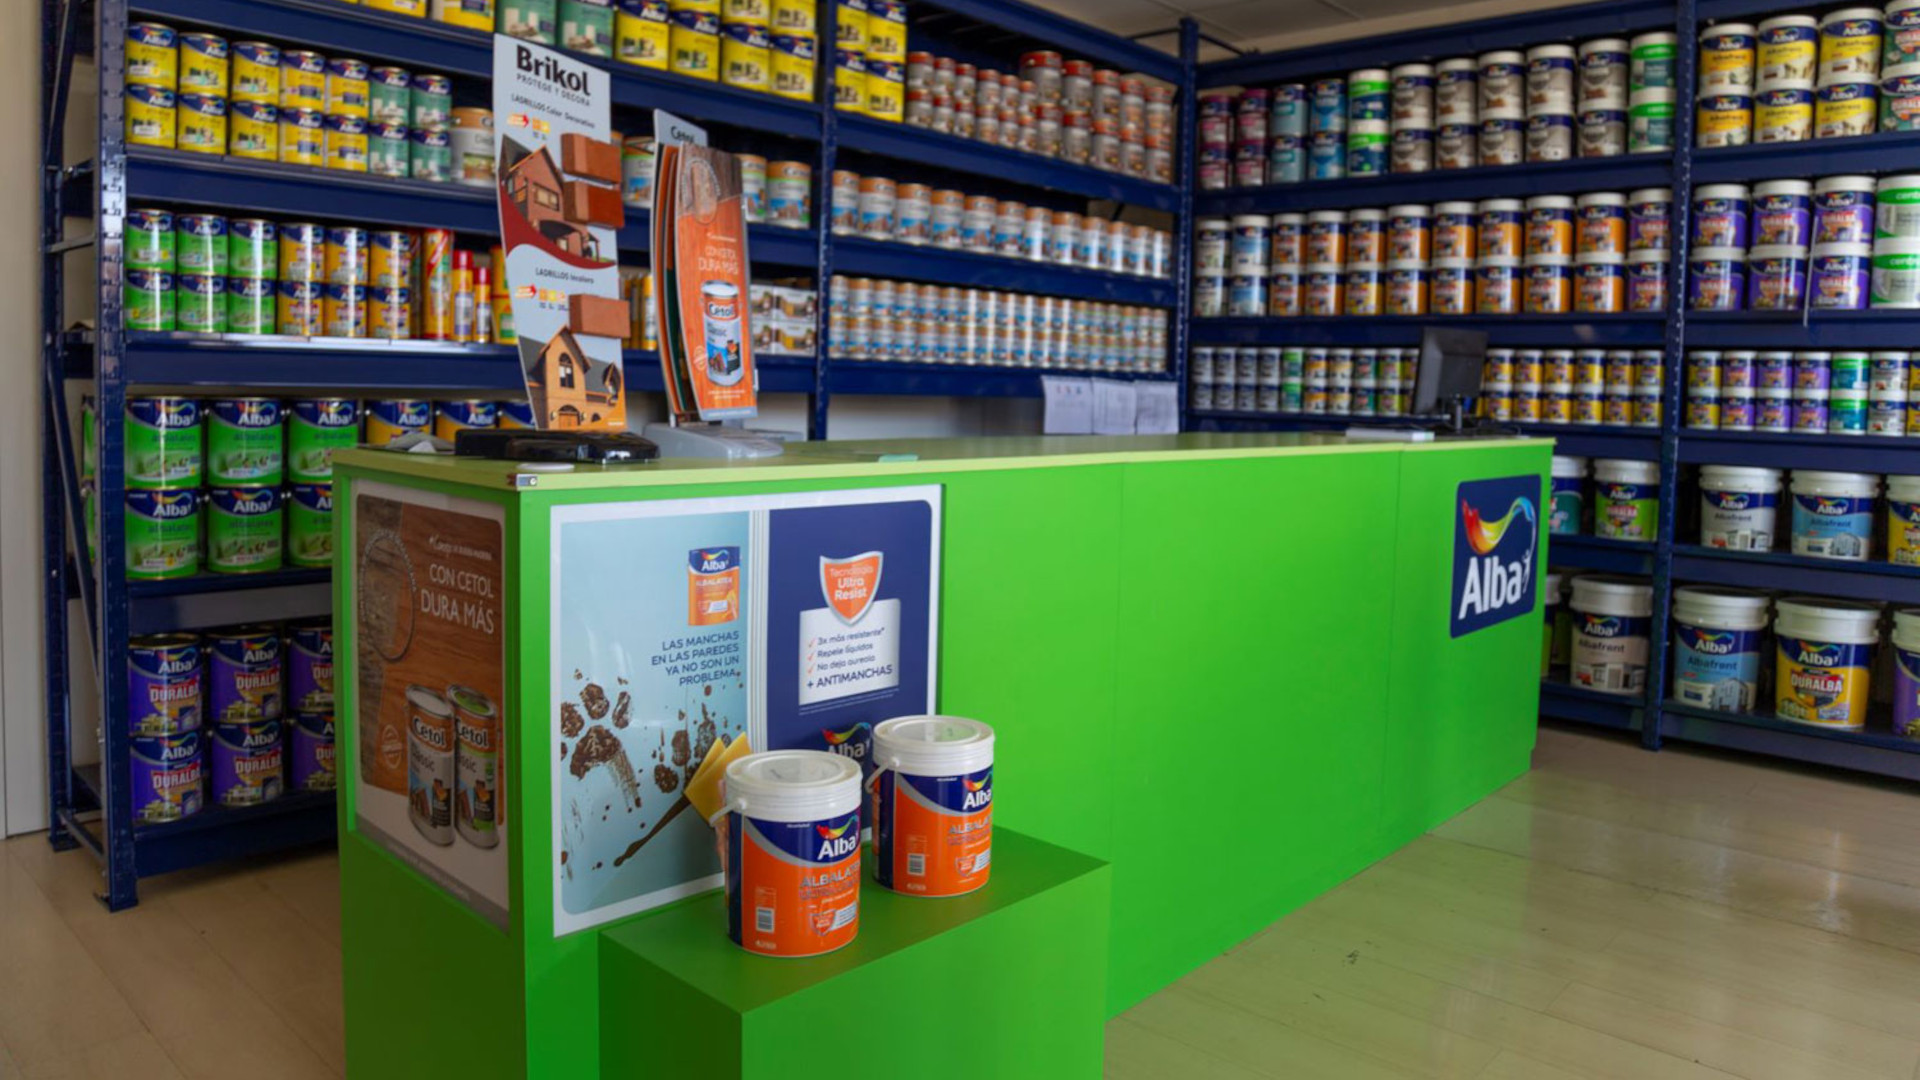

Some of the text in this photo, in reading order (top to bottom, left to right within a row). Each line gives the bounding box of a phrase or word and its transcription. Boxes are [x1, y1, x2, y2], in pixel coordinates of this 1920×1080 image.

[516, 44, 591, 97] Brikol
[708, 302, 735, 318] Cetol
[156, 412, 191, 426] Alba
[238, 412, 273, 426] Alba
[318, 412, 351, 426] Alba
[153, 503, 189, 518] Alba
[233, 500, 268, 514] Alba
[1720, 498, 1747, 510] Alba
[1817, 504, 1846, 515] Alba
[702, 560, 725, 571] Alba
[430, 564, 494, 598] CON CETOL
[837, 577, 865, 589] Ultra
[1458, 555, 1522, 620] Alba
[835, 587, 867, 600] Resist
[421, 589, 494, 634] DURA MÁS
[1584, 622, 1614, 637] Alba
[662, 630, 740, 651] LAS MANCHAS
[1695, 639, 1727, 654] Alba
[243, 649, 275, 663] Alba
[651, 643, 740, 666] EN LAS PAREDES
[817, 647, 845, 659] Repele
[1798, 650, 1834, 667] Alba
[158, 660, 192, 674] Alba
[665, 655, 740, 676] YA NO SON UN
[817, 662, 829, 672] No
[829, 658, 848, 671] deja
[816, 664, 893, 688] ANTIMANCHAS
[1791, 673, 1843, 693] DURALBA
[413, 717, 445, 747] Cetol
[243, 734, 274, 748] Alba
[161, 746, 194, 760] Alba
[963, 788, 991, 810] Alba
[818, 835, 857, 861] Alba
